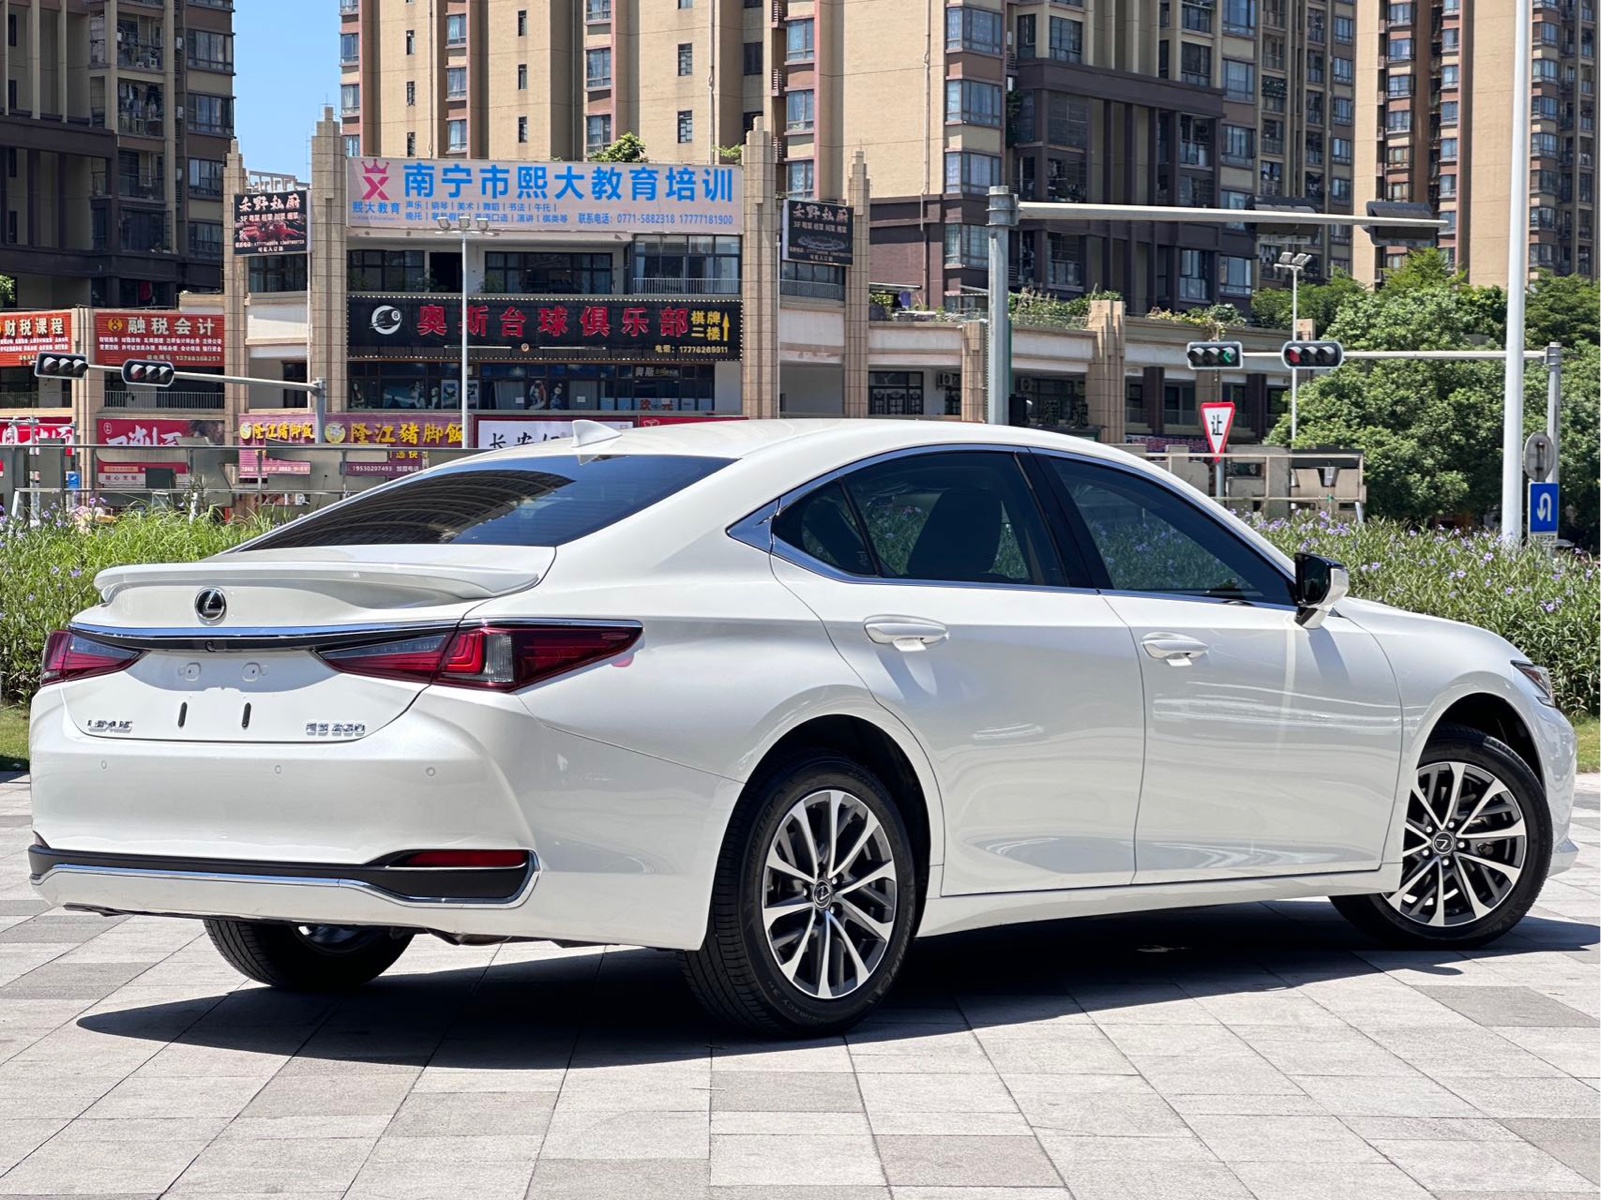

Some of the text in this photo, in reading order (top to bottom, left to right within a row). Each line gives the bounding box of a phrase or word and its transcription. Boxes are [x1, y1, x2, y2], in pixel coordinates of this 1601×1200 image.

[403, 162, 733, 202] 南宁市熙大教育培训
[352, 201, 400, 214] 熙大教育
[457, 202, 474, 211] 美术
[509, 203, 526, 212] 书法
[617, 213, 675, 224] 0771-5882318
[679, 214, 734, 225] 17777181900
[417, 305, 689, 338] 奥斯台球俱乐部
[691, 310, 721, 325] 棋牌
[5, 318, 63, 336] 财税课程
[128, 317, 215, 335] 融税会计
[691, 326, 721, 341] 二楼
[1211, 414, 1223, 436] 让
